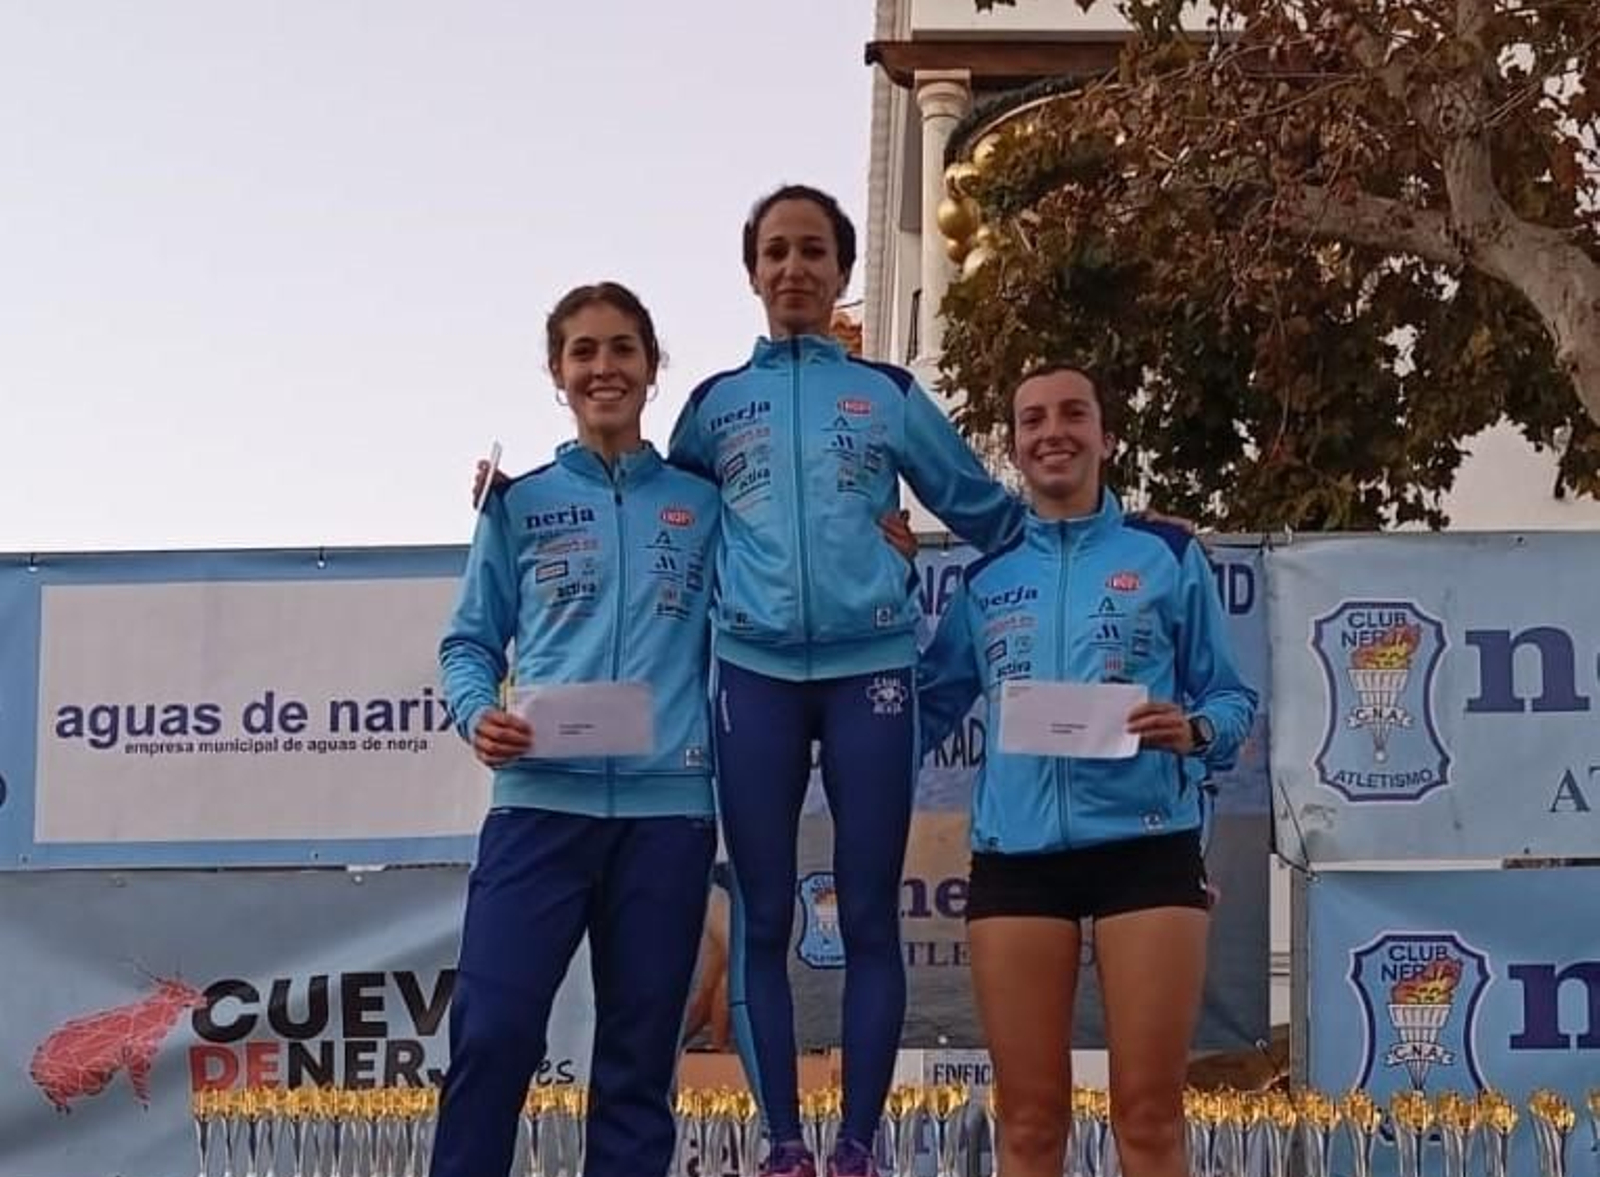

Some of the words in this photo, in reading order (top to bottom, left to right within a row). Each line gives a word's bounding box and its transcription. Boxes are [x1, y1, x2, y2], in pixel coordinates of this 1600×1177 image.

[709, 401, 771, 431] nerja
[525, 505, 596, 529] nerja
[56, 698, 222, 749] aguas
[242, 691, 308, 735] de
[124, 739, 195, 756] empresa
[198, 736, 279, 755] municipal
[282, 737, 304, 752] de
[307, 738, 357, 754] aguas
[361, 737, 383, 752] de
[387, 735, 428, 754] nerja
[1333, 768, 1434, 789] ATLETISMO
